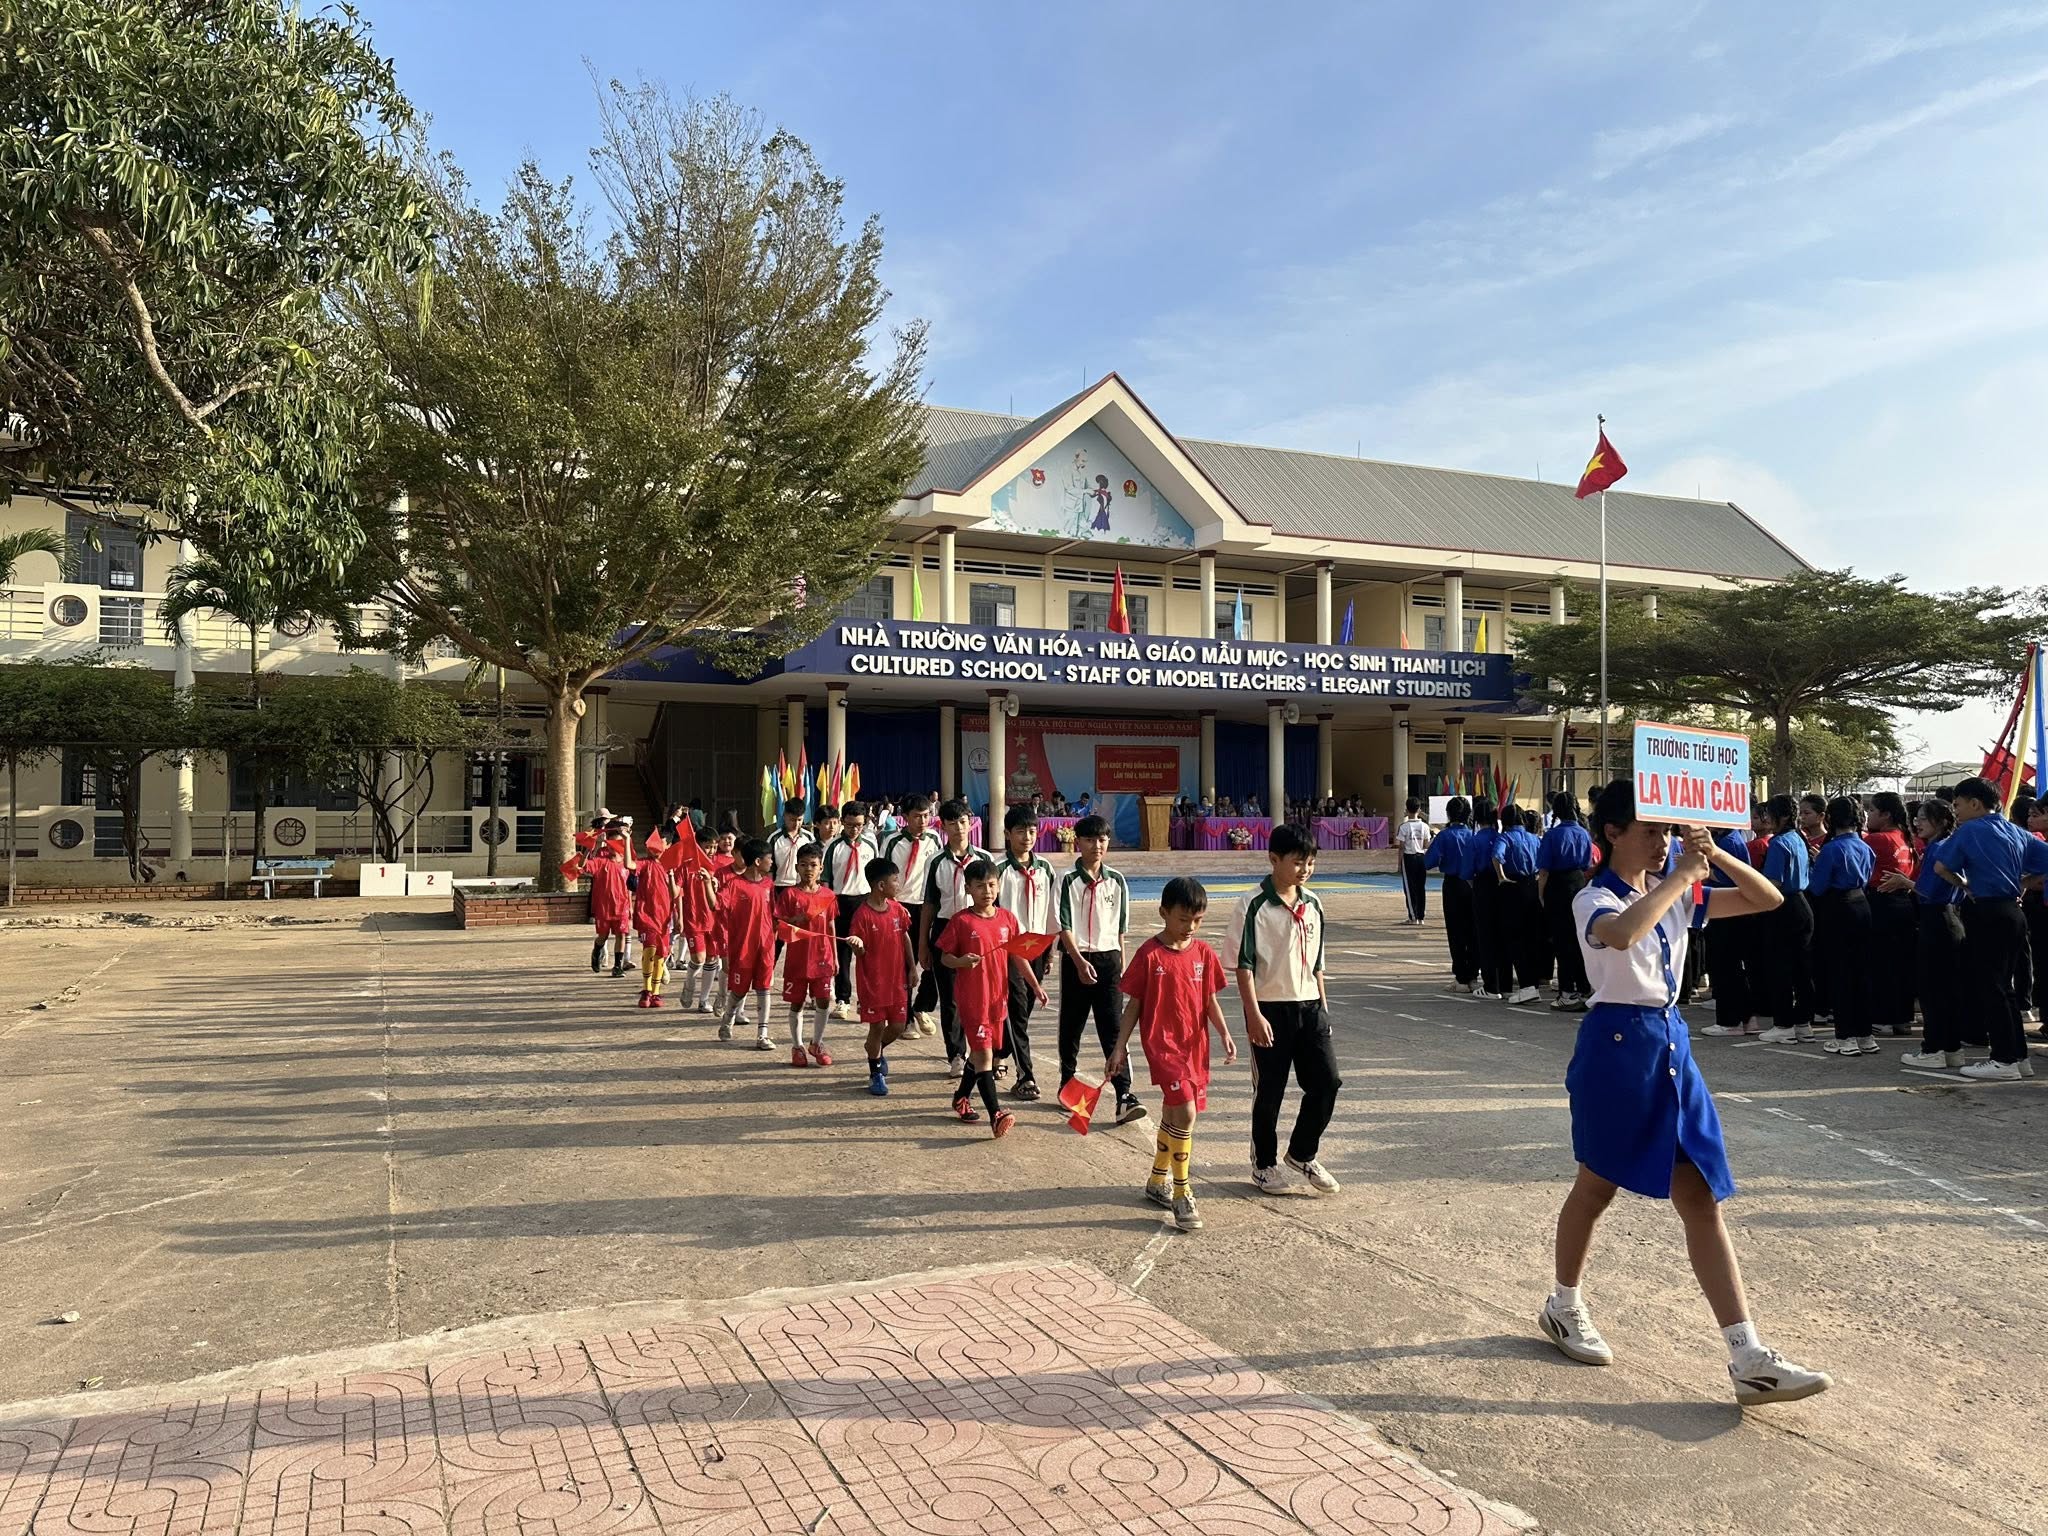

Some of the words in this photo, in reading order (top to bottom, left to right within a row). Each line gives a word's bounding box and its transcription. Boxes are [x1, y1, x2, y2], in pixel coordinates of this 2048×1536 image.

[841, 622, 890, 647] NHÀ
[899, 625, 987, 651] TRƯỜNG
[992, 633, 1033, 655] VĂN
[1040, 633, 1083, 657] HÓA
[1100, 637, 1140, 660] NHÀ
[1146, 640, 1196, 663] GIÁO
[1202, 641, 1242, 665] MẪU
[1247, 647, 1288, 671] MỰC
[1304, 652, 1343, 673] HỌC
[1349, 655, 1387, 672] SINH
[1391, 656, 1446, 675] THANH
[1451, 659, 1486, 678] LỊCH
[850, 654, 955, 677] CULTURED
[961, 659, 1047, 681] SCHOOL
[1066, 664, 1120, 684] STAFF
[1126, 667, 1151, 685] OF
[1156, 669, 1217, 688] MODEL
[1220, 671, 1306, 692] TEACHERS
[1322, 677, 1391, 694] ELEGANT
[1396, 681, 1472, 698] STUDENTS
[1647, 735, 1690, 760] TRƯỜNG
[1693, 737, 1715, 762] TIỂU
[1717, 746, 1738, 769] HỌC
[1638, 772, 1662, 805] LA
[1667, 770, 1705, 809] VĂN
[1710, 771, 1746, 814] CẦU
[379, 867, 385, 878] 1
[427, 875, 434, 885] 2
[785, 982, 794, 995] 2
